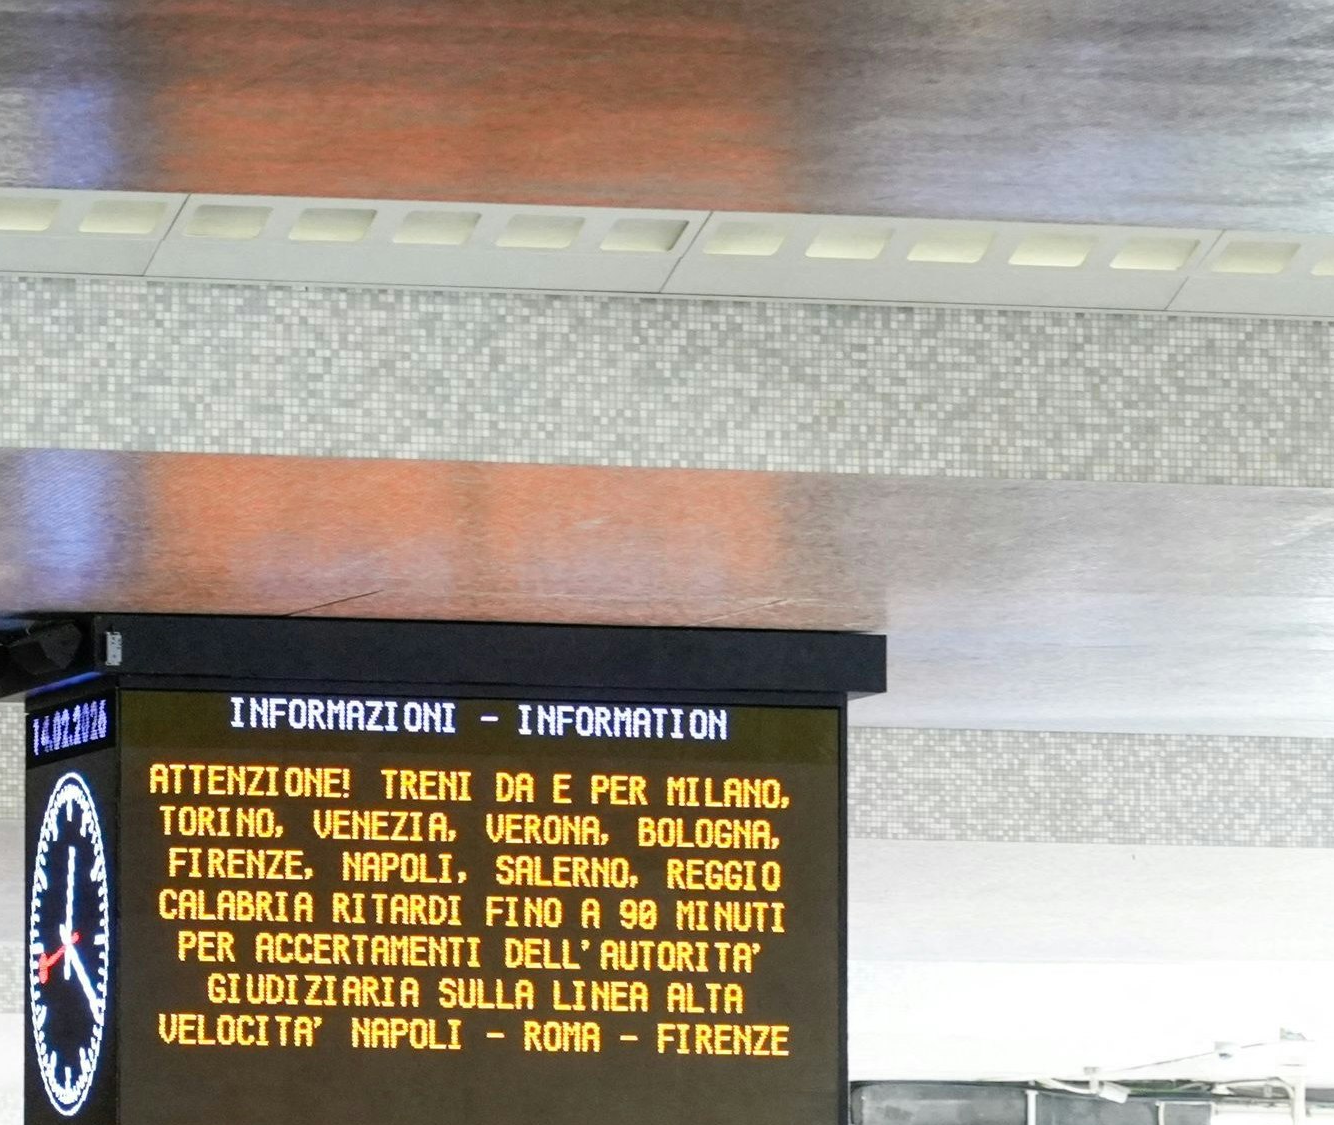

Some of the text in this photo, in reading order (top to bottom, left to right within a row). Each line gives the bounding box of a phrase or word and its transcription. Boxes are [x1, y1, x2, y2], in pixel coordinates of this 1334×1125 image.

[231, 697, 455, 733] INFORMAZIONI
[519, 705, 727, 739] INFORMATION
[150, 763, 789, 808] ATTENZIONE! TRENI DA E PER MILANO,
[160, 806, 779, 849] TORINO, VENEZIA, VERONA, BOLOGNA,
[169, 847, 781, 891] FIRENZE, NAPOLI, SALERNO, REGGIO
[159, 889, 785, 932] CALABRIA RITARDI FINO A 90 MINUTI
[178, 931, 235, 962] PER
[255, 932, 481, 967] ACCERTAMENTI
[207, 973, 744, 1014] GIUDIZIARIA SULLA LINEA ALTA
[159, 1014, 322, 1046] VELOCITA'
[352, 1017, 462, 1049] NAPOLI
[524, 1020, 600, 1052] ROMA
[657, 1023, 789, 1056] FIRENZE
